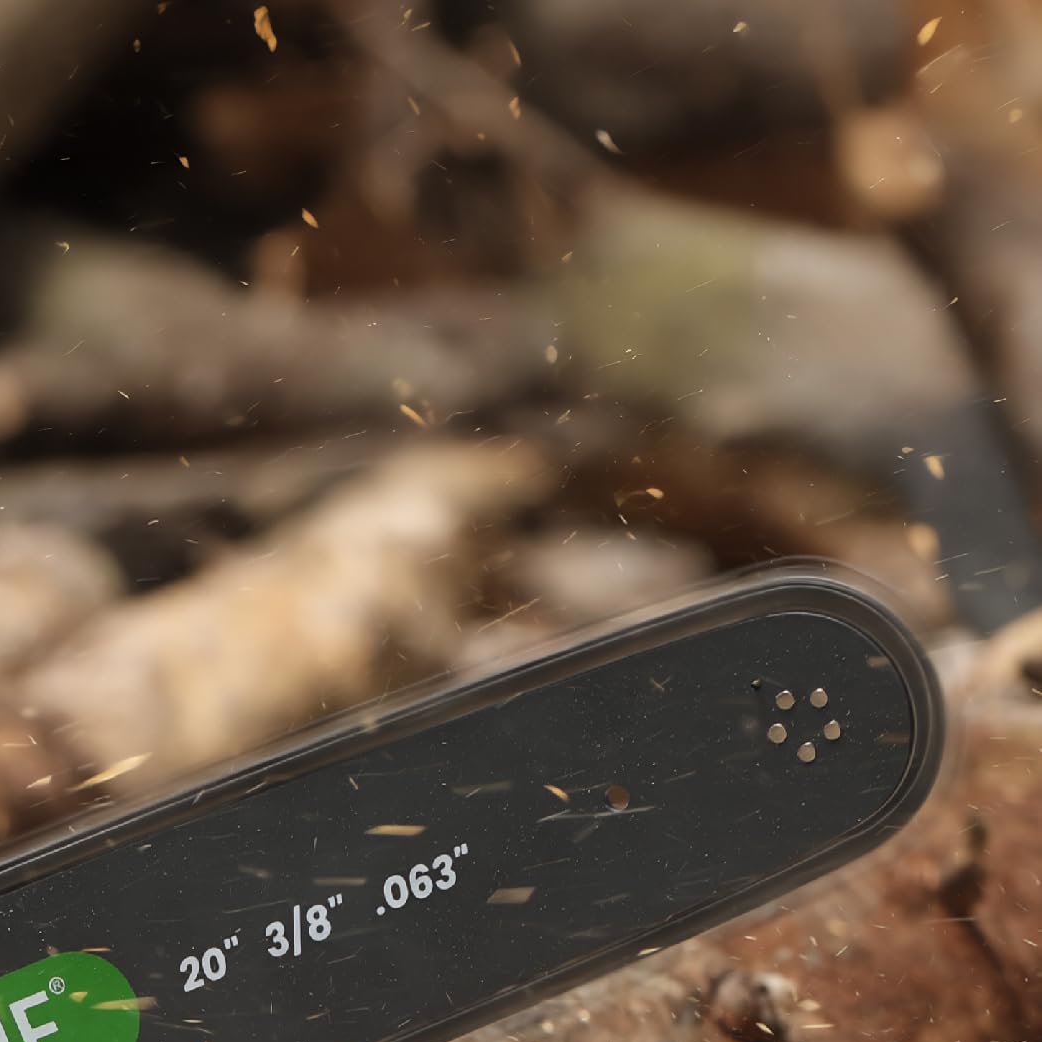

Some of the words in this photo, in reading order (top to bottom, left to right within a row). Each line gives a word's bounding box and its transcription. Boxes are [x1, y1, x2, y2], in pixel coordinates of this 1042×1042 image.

[179, 935, 239, 993] 20"
[265, 893, 343, 957] 3/8"
[376, 843, 469, 916] .063"
